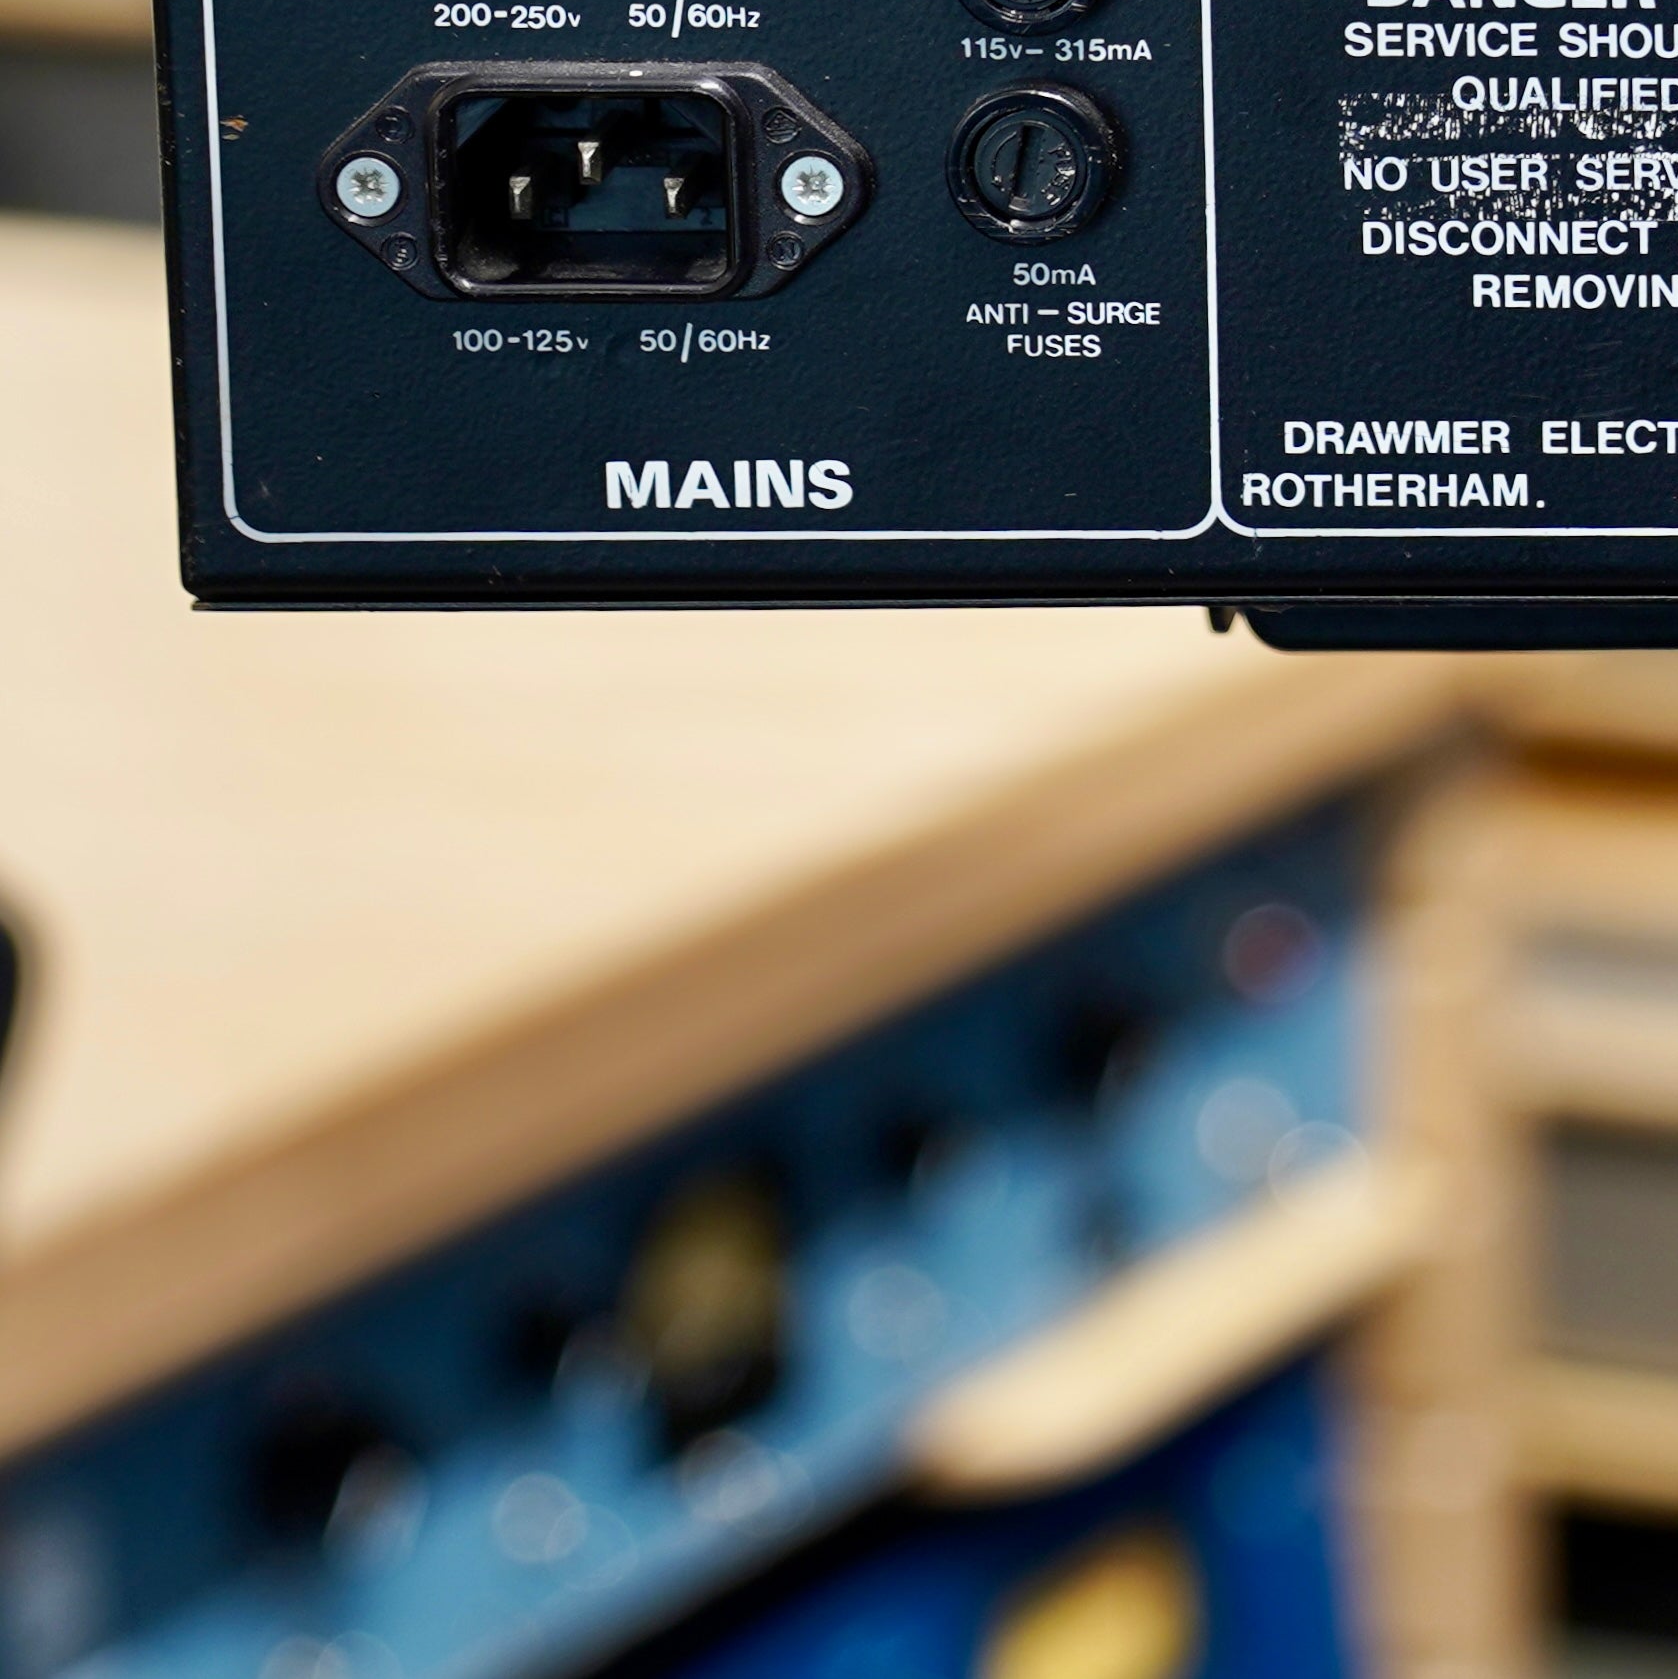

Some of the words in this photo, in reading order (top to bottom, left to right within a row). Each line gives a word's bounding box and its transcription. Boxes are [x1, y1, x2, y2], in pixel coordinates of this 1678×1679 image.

[1056, 39, 1152, 61] 315mA
[1345, 22, 1537, 57] SERVICE
[1343, 158, 1407, 193] NO
[1432, 157, 1548, 194] USER
[1361, 221, 1658, 257] DISCONNECT
[1014, 263, 1096, 285] 50mA
[967, 304, 1028, 324] ANTI
[1068, 302, 1160, 324] SURGE
[1008, 335, 1101, 357] FUSES
[1284, 421, 1510, 454] DRAWMER
[606, 460, 853, 509] MAINS
[1241, 473, 1544, 508] ROTHERHAM.
